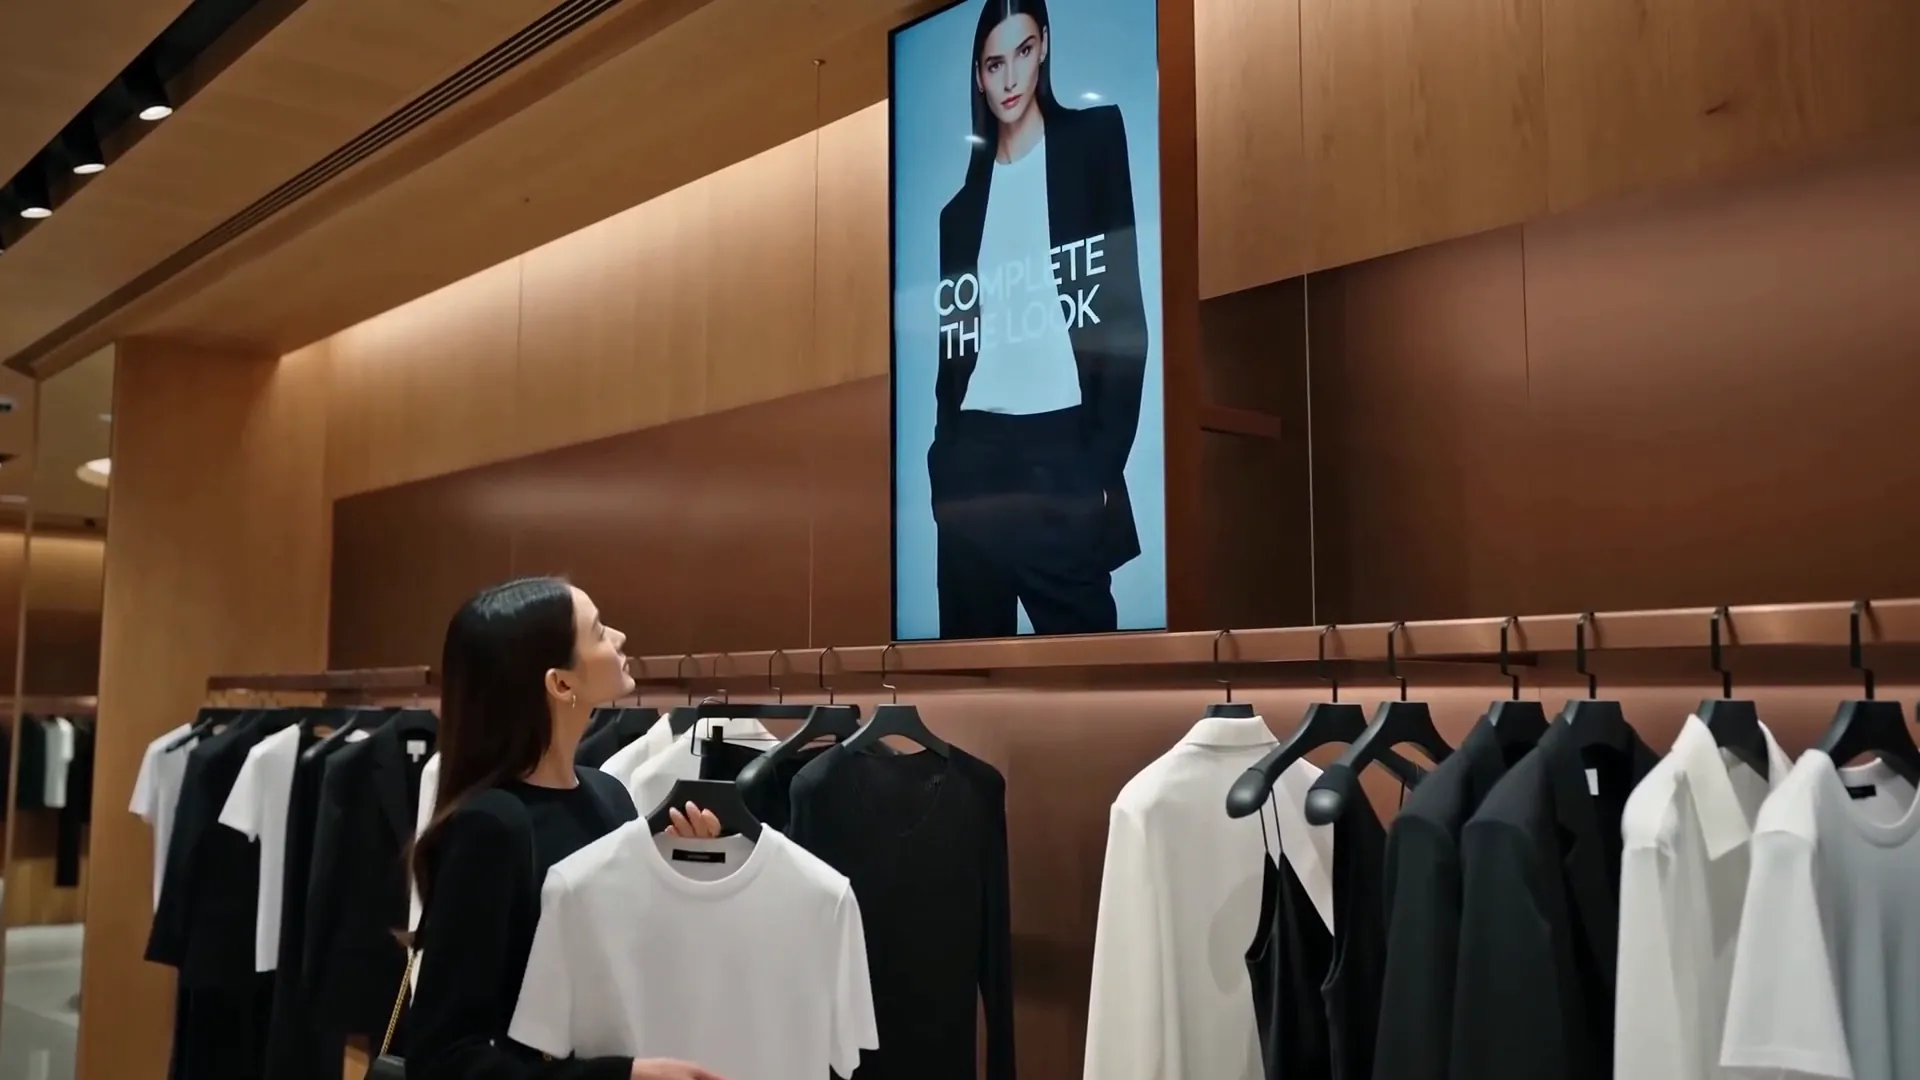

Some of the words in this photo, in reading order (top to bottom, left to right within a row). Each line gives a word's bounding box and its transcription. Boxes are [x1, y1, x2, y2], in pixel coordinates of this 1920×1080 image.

[934, 233, 1106, 317] COMPLETE
[940, 313, 997, 360] THE
[1007, 284, 1100, 344] LOOK
